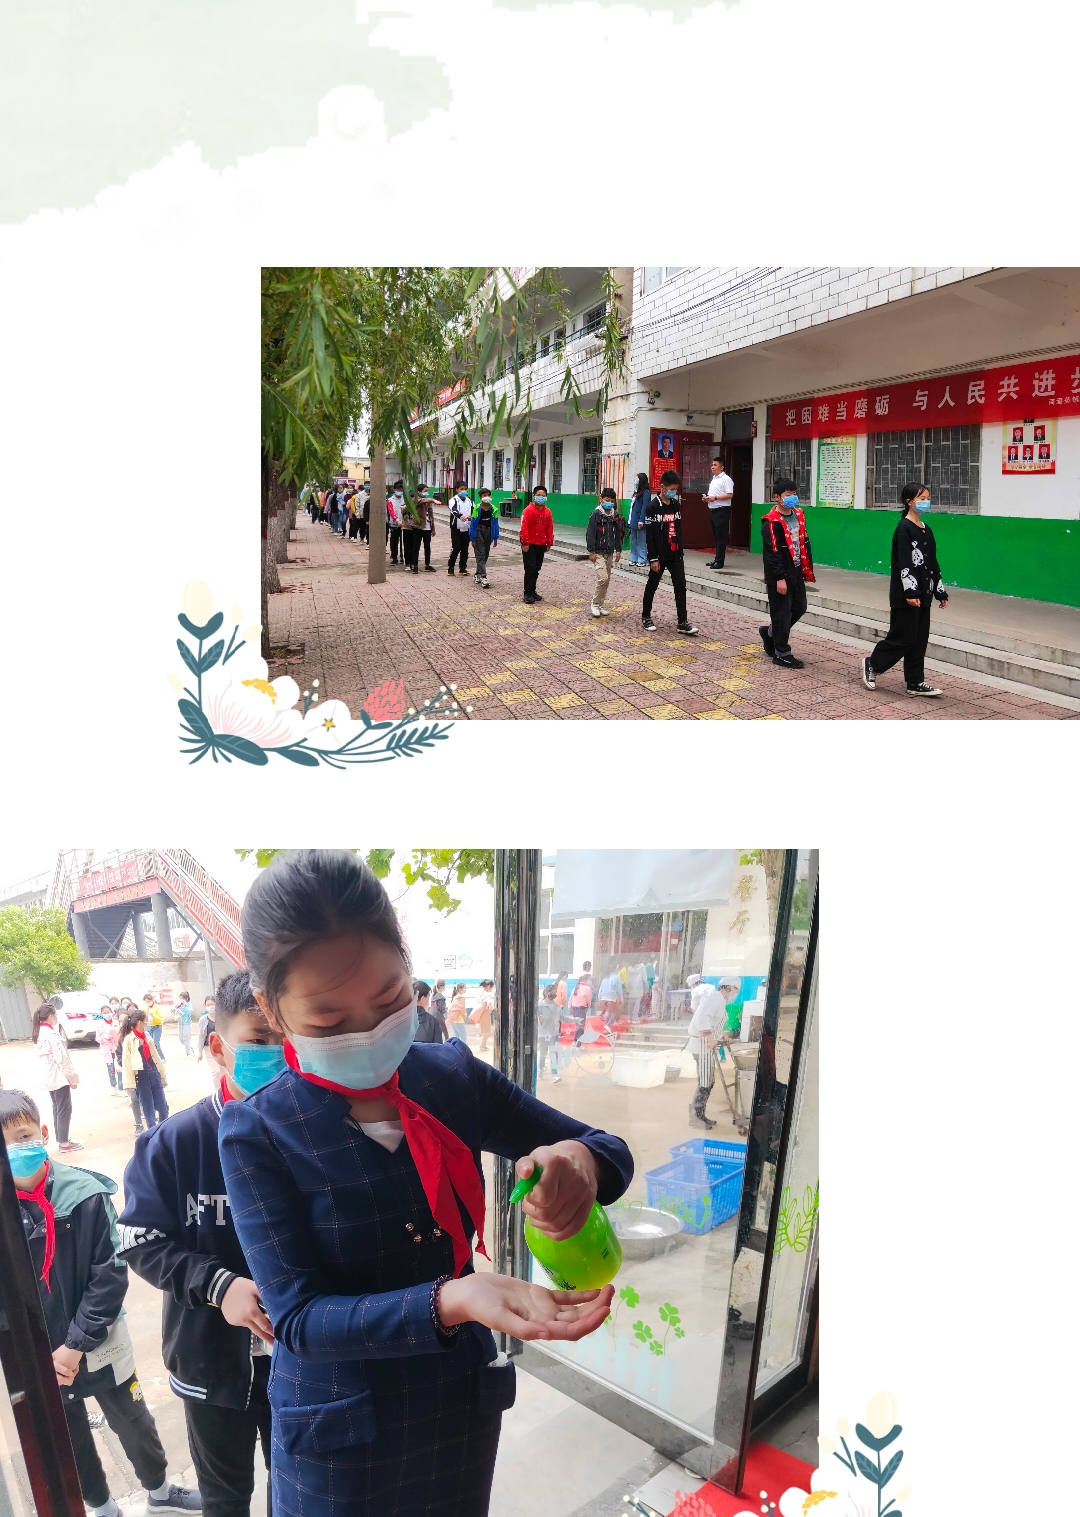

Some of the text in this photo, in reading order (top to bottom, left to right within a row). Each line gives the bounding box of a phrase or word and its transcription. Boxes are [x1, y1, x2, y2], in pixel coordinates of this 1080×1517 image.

[786, 394, 890, 426] 把困难当磨砺
